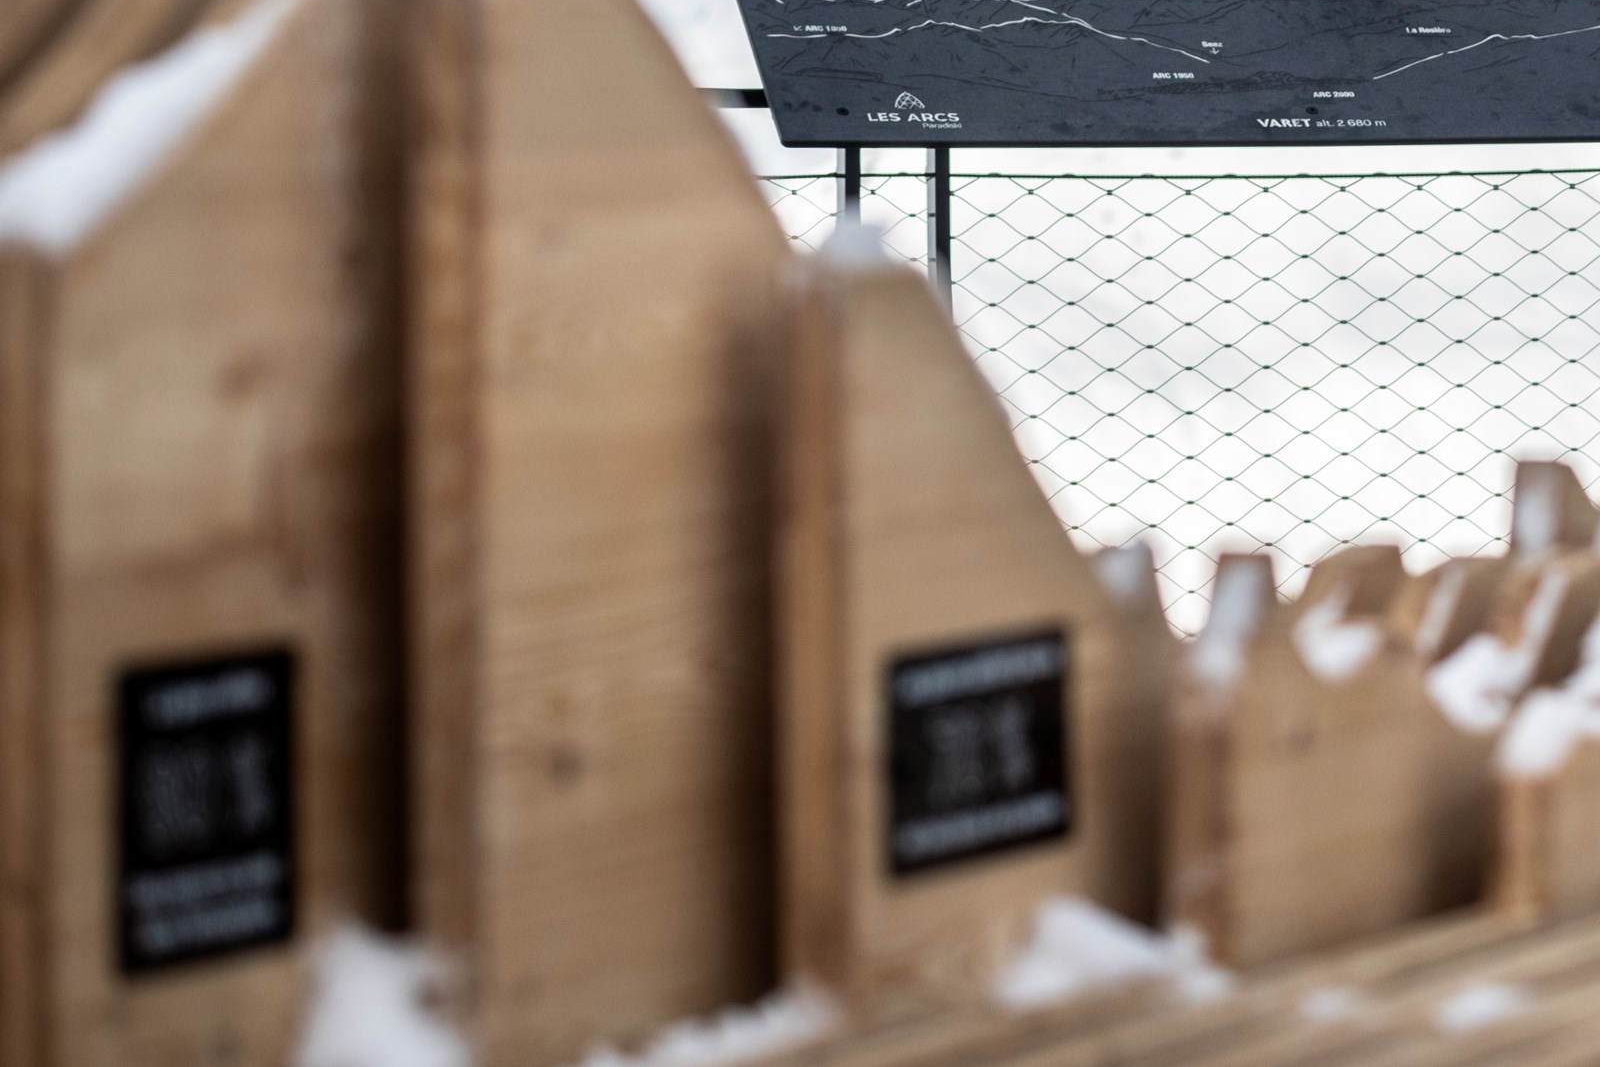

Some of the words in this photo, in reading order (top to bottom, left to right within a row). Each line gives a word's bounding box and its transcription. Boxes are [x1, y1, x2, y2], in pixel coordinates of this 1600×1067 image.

[804, 24, 825, 32] ARC
[866, 112, 901, 122] LES
[907, 112, 960, 122] ARCS
[922, 122, 963, 130] Paradiski
[1256, 118, 1312, 128] VARET
[1315, 119, 1335, 127] alt.
[1336, 119, 1345, 127] 2
[1347, 119, 1372, 127] 680
